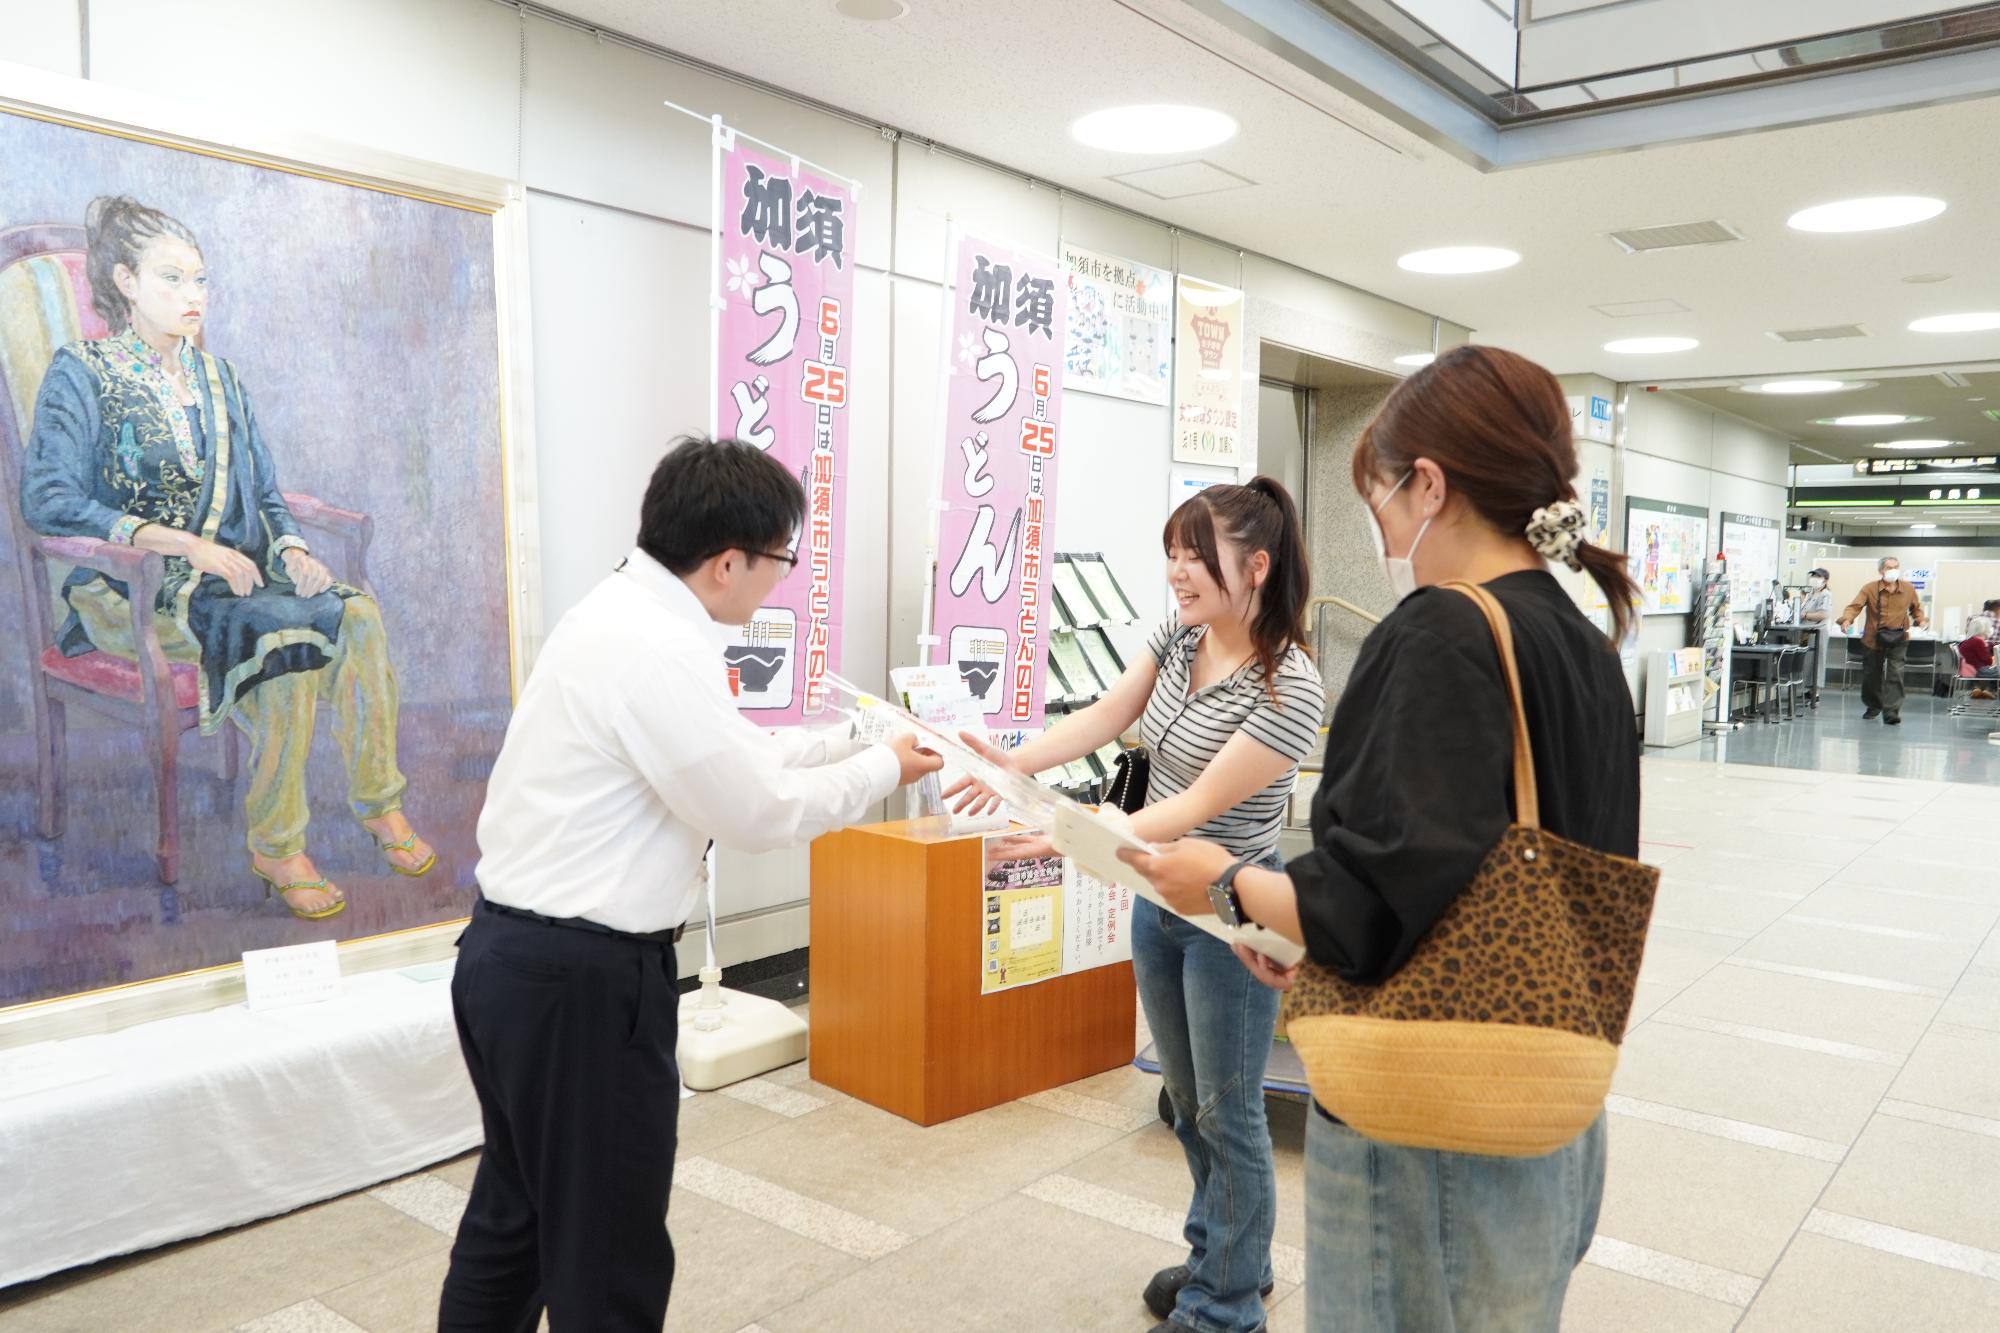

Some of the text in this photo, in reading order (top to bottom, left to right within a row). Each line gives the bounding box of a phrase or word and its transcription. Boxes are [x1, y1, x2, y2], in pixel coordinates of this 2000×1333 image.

[741, 165, 844, 270] 加須
[969, 255, 1054, 341] 加須
[950, 326, 1022, 603] うどん
